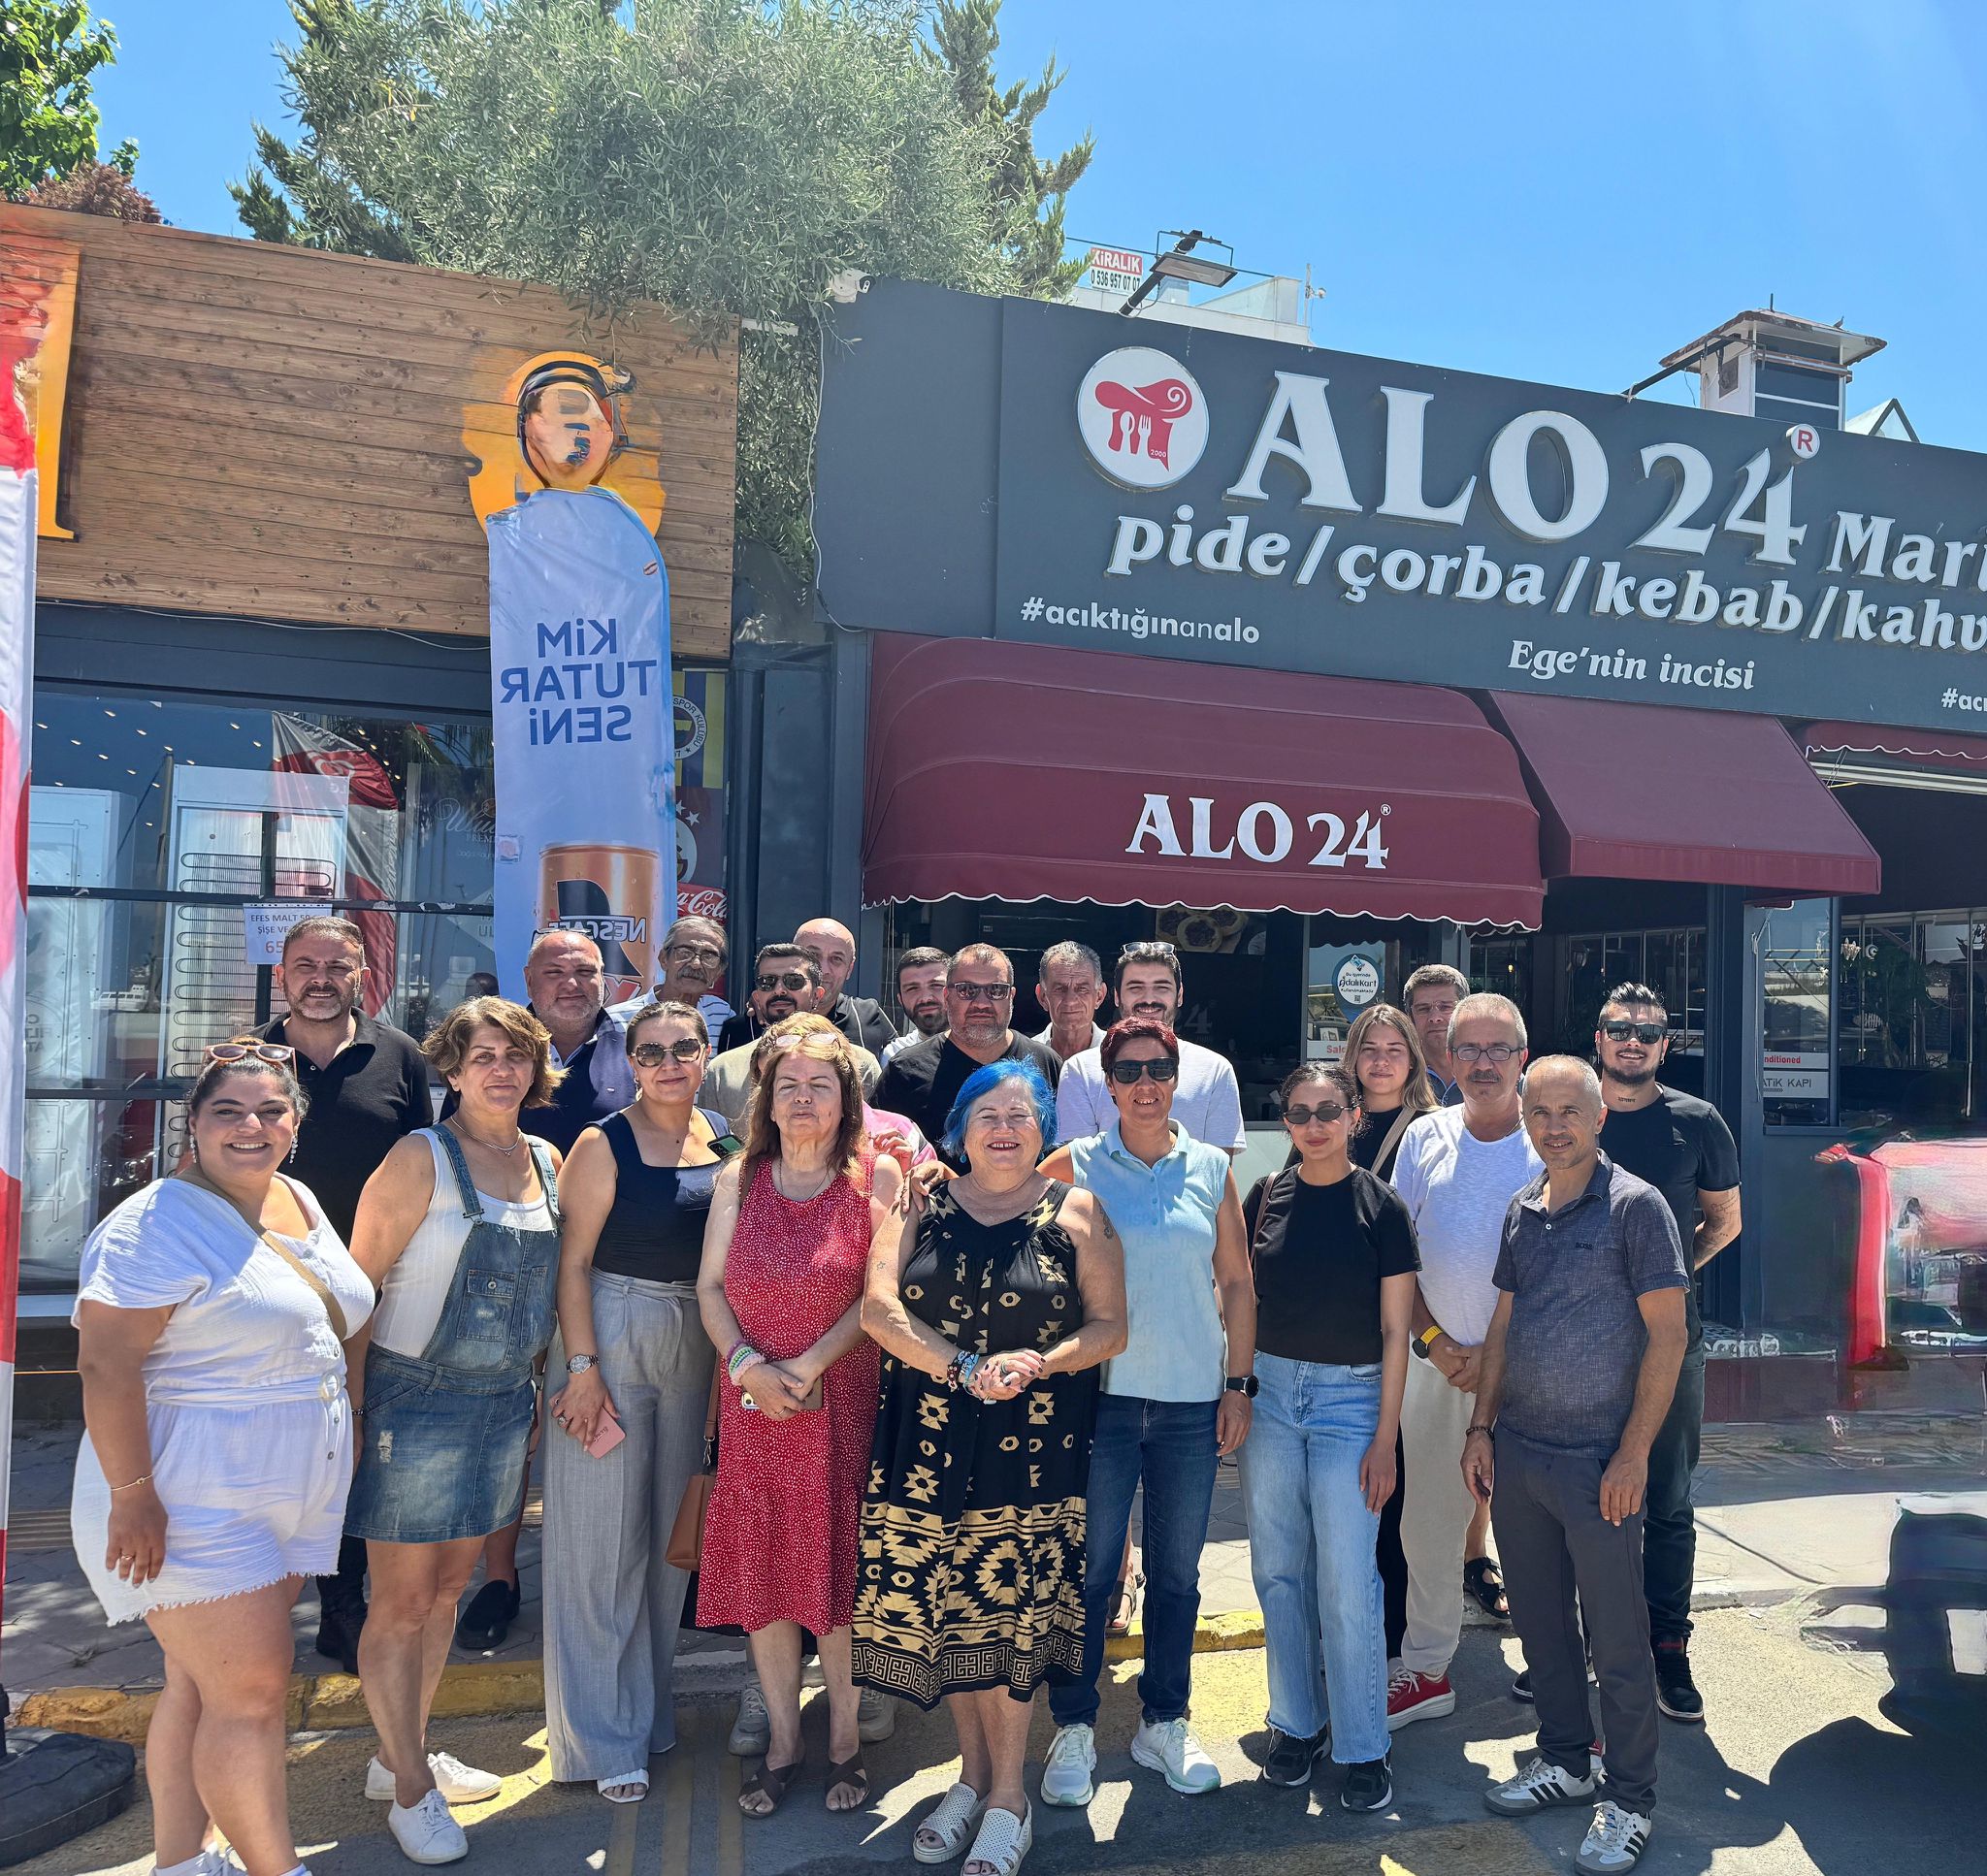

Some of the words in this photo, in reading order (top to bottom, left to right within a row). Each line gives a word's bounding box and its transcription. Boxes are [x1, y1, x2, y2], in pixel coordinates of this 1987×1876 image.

[1091, 269, 1095, 284] 0
[1097, 270, 1109, 287] 536
[1110, 273, 1122, 289] 957
[1124, 275, 1131, 290] 07
[1226, 371, 1610, 540] ALO
[1627, 442, 1808, 566] 24
[1659, 653, 1754, 690] incisi
[1125, 793, 1293, 863] ALO
[1307, 810, 1389, 869] 24
[250, 914, 270, 922] EFES
[1764, 1055, 1801, 1064] nditioned
[1787, 1078, 1811, 1088] KAPI
